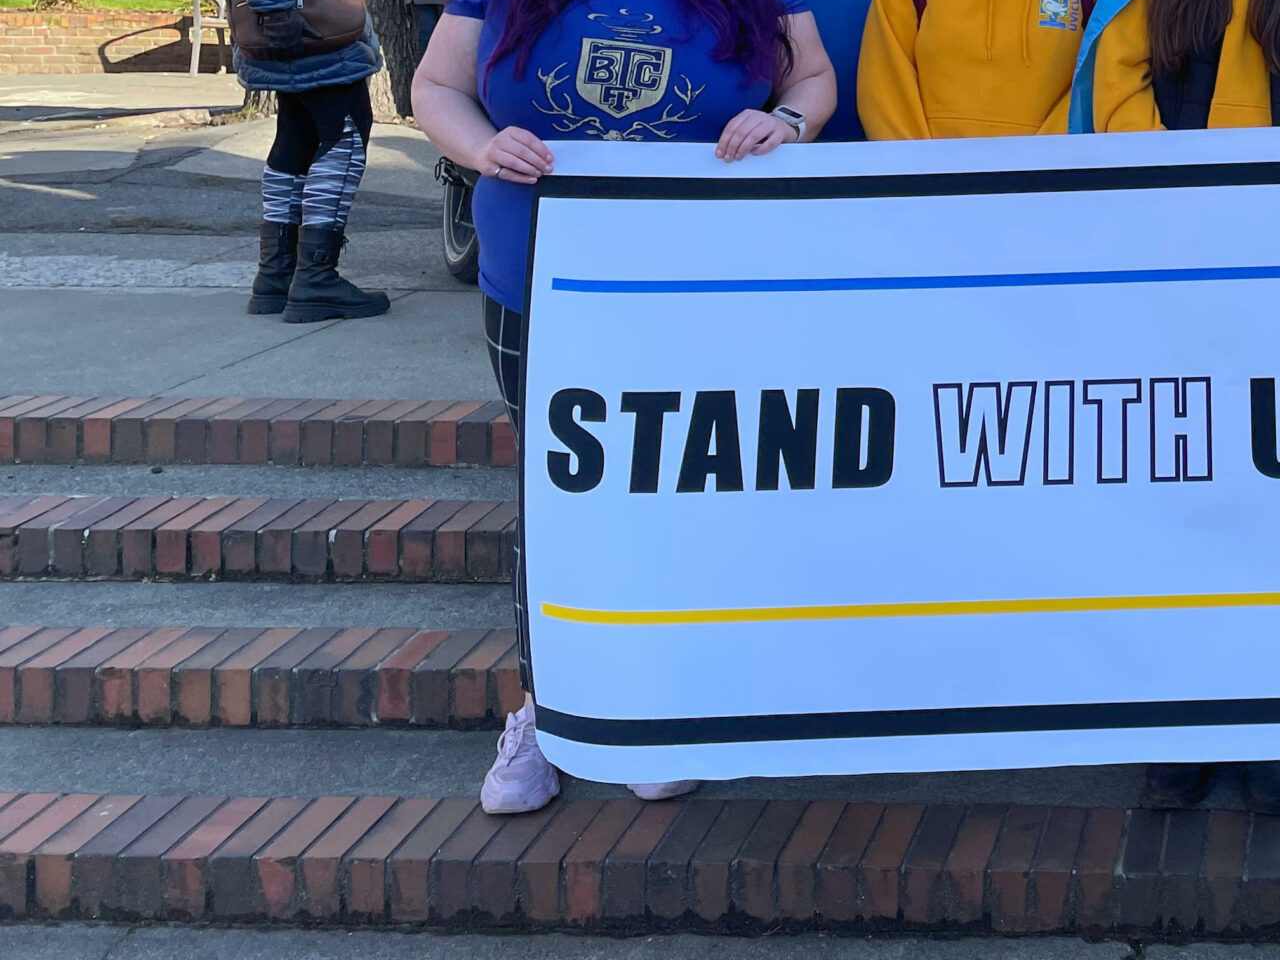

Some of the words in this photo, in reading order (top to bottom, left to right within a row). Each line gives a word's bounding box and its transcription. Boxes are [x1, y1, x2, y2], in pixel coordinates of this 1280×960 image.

[584, 42, 665, 91] BTC
[547, 387, 895, 493] STAND
[933, 376, 1213, 488] WITH
